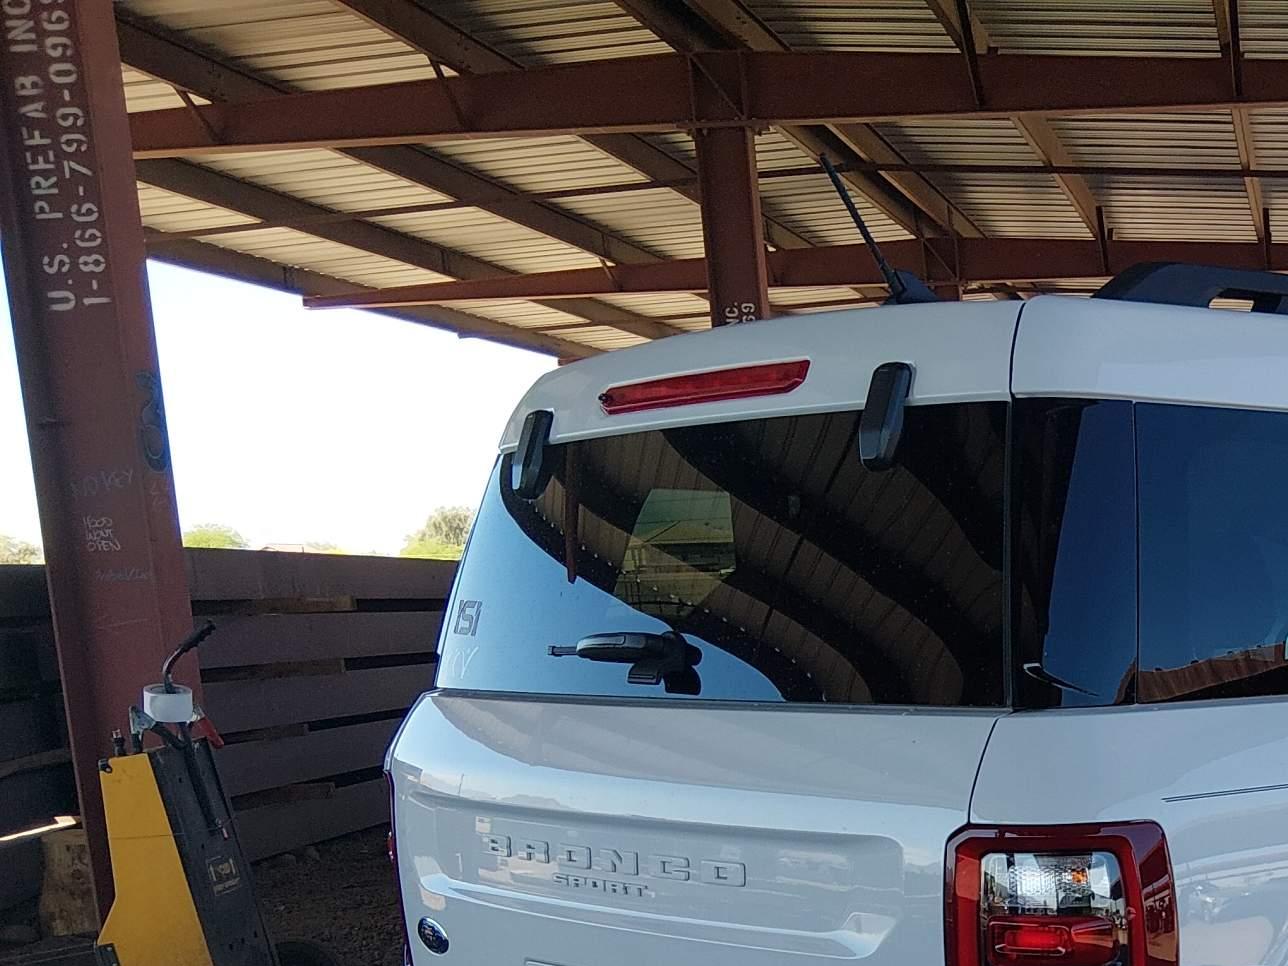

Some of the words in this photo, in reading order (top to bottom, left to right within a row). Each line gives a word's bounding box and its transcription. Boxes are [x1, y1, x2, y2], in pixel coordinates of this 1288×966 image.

[14, 74, 63, 220] PREFAB
[40, 0, 112, 306] 1-866-799-096
[42, 243, 76, 311] U.S.
[87, 538, 121, 552] OPEN
[481, 833, 747, 888] BRONCO
[552, 873, 649, 898] SPORT
